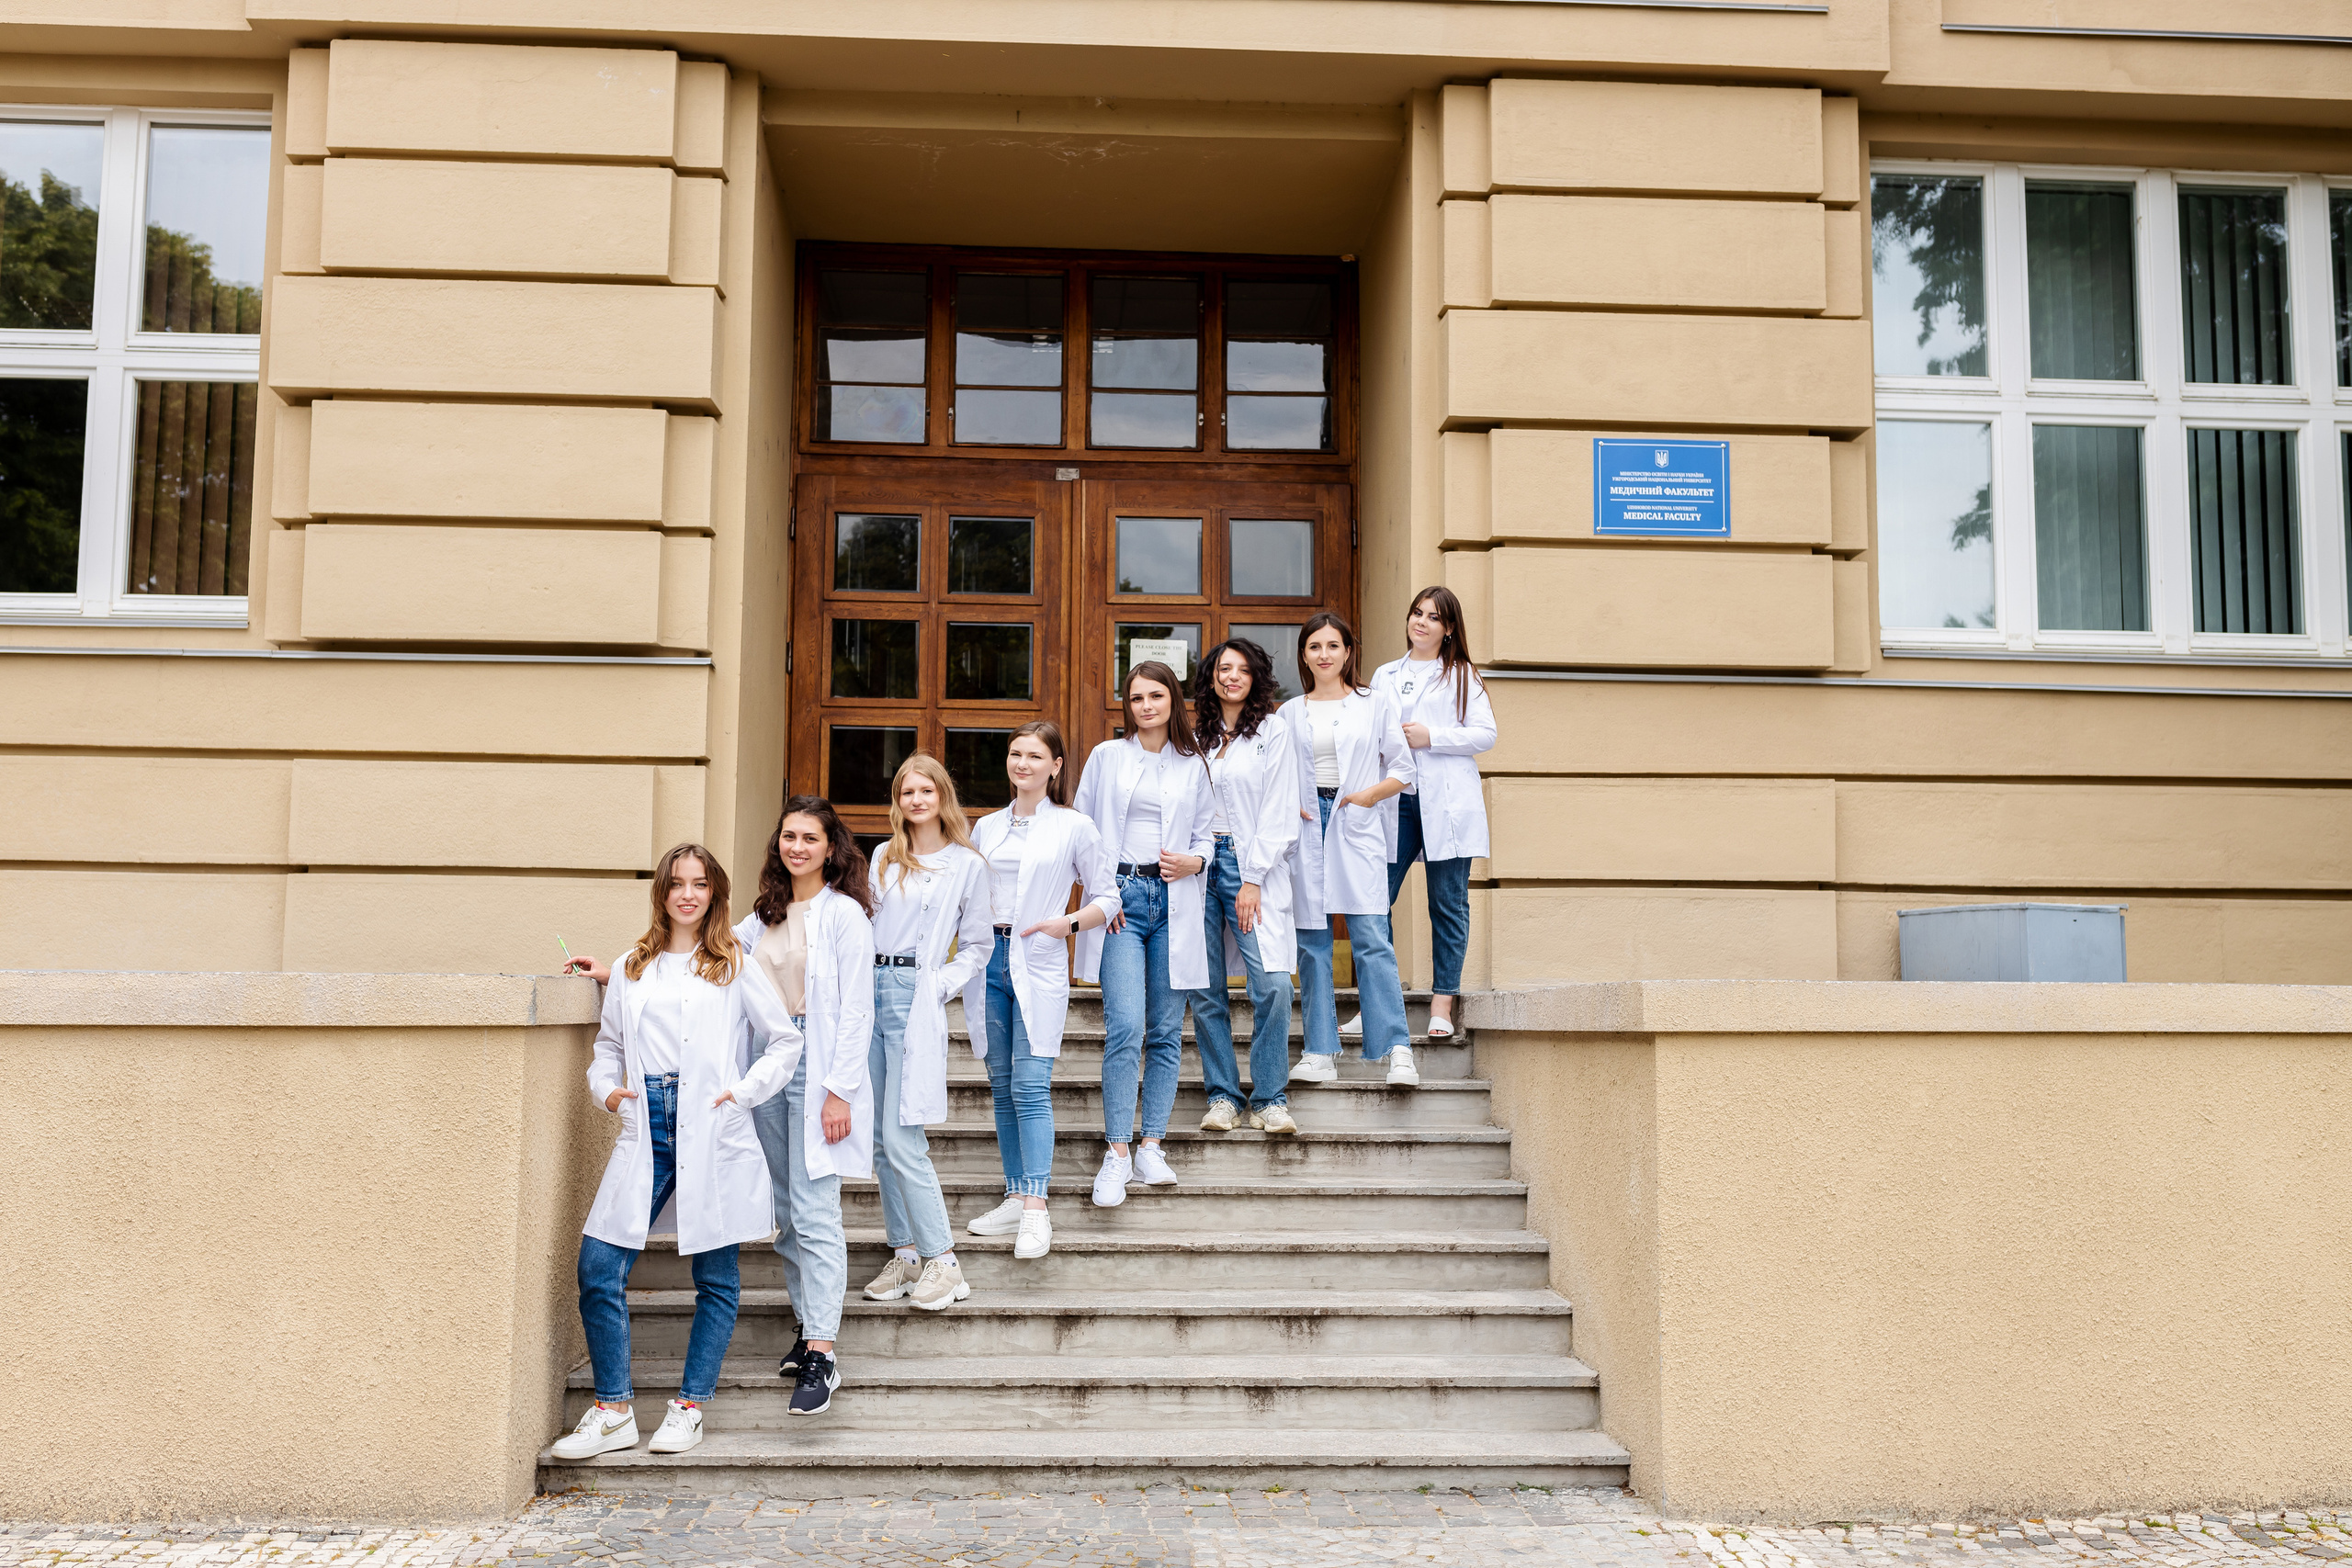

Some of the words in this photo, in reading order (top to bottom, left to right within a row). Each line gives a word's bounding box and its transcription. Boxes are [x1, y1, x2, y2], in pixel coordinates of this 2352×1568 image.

[1610, 486, 1663, 496] МЕДИЧНИЙ
[1663, 488, 1714, 497] ФАКУЛЬТЕТ
[1623, 512, 1663, 520] MEDICAL
[1664, 513, 1702, 521] FACULTY
